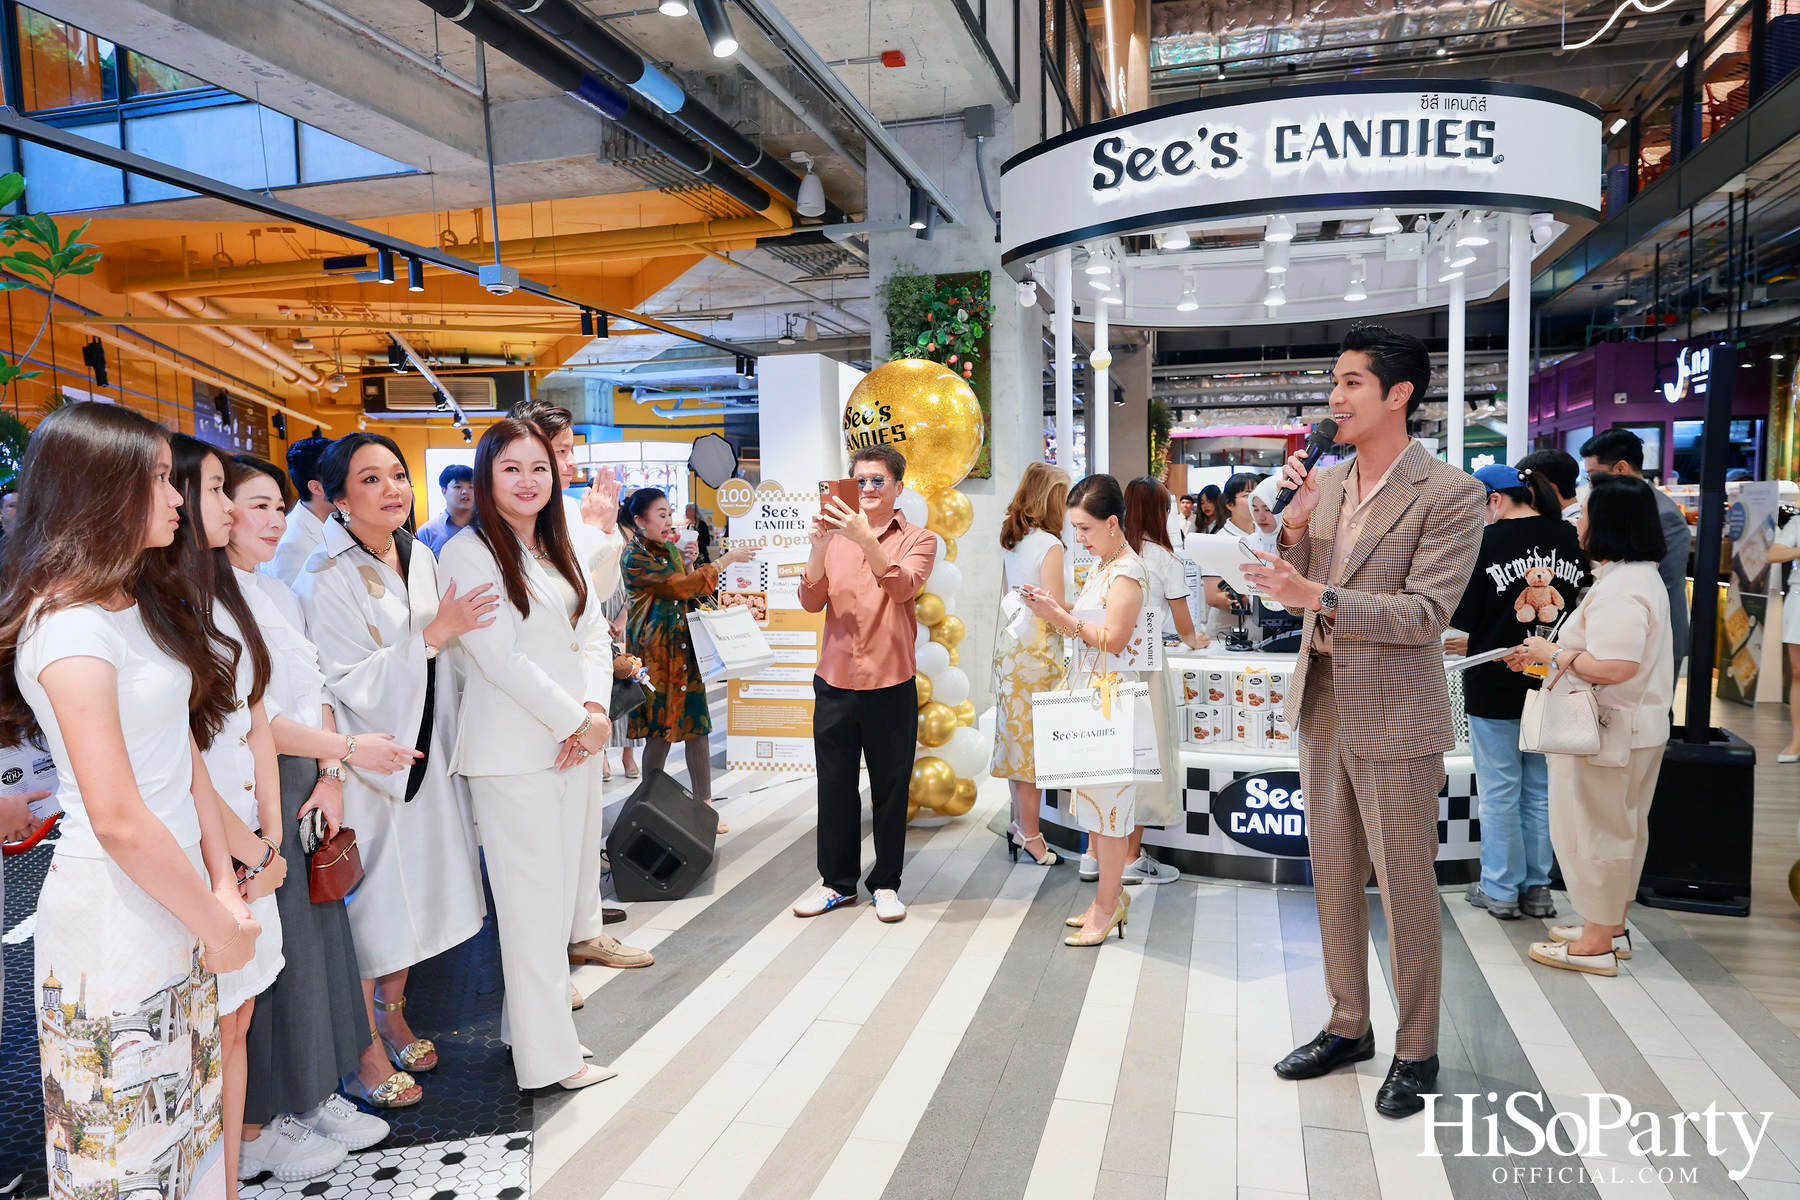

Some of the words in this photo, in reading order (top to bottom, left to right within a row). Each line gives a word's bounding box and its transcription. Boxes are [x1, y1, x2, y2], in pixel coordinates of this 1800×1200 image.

[1420, 94, 1439, 110] ซีส์
[1444, 96, 1487, 112] แคนดีส์
[1093, 127, 1239, 191] See's
[1275, 118, 1496, 163] CANDIES
[844, 400, 892, 430] See's
[846, 424, 907, 451] ANDIES
[720, 488, 751, 503] 100
[761, 504, 799, 518] See's
[755, 520, 805, 530] CANDIES
[720, 535, 768, 549] Grand
[772, 534, 811, 548] Open
[779, 567, 793, 575] Get
[794, 566, 806, 574] No
[1146, 612, 1155, 634] See's
[1052, 730, 1078, 741] See's
[1080, 727, 1116, 739] CANDIES
[1245, 778, 1305, 811] See
[1230, 811, 1308, 837] CAND
